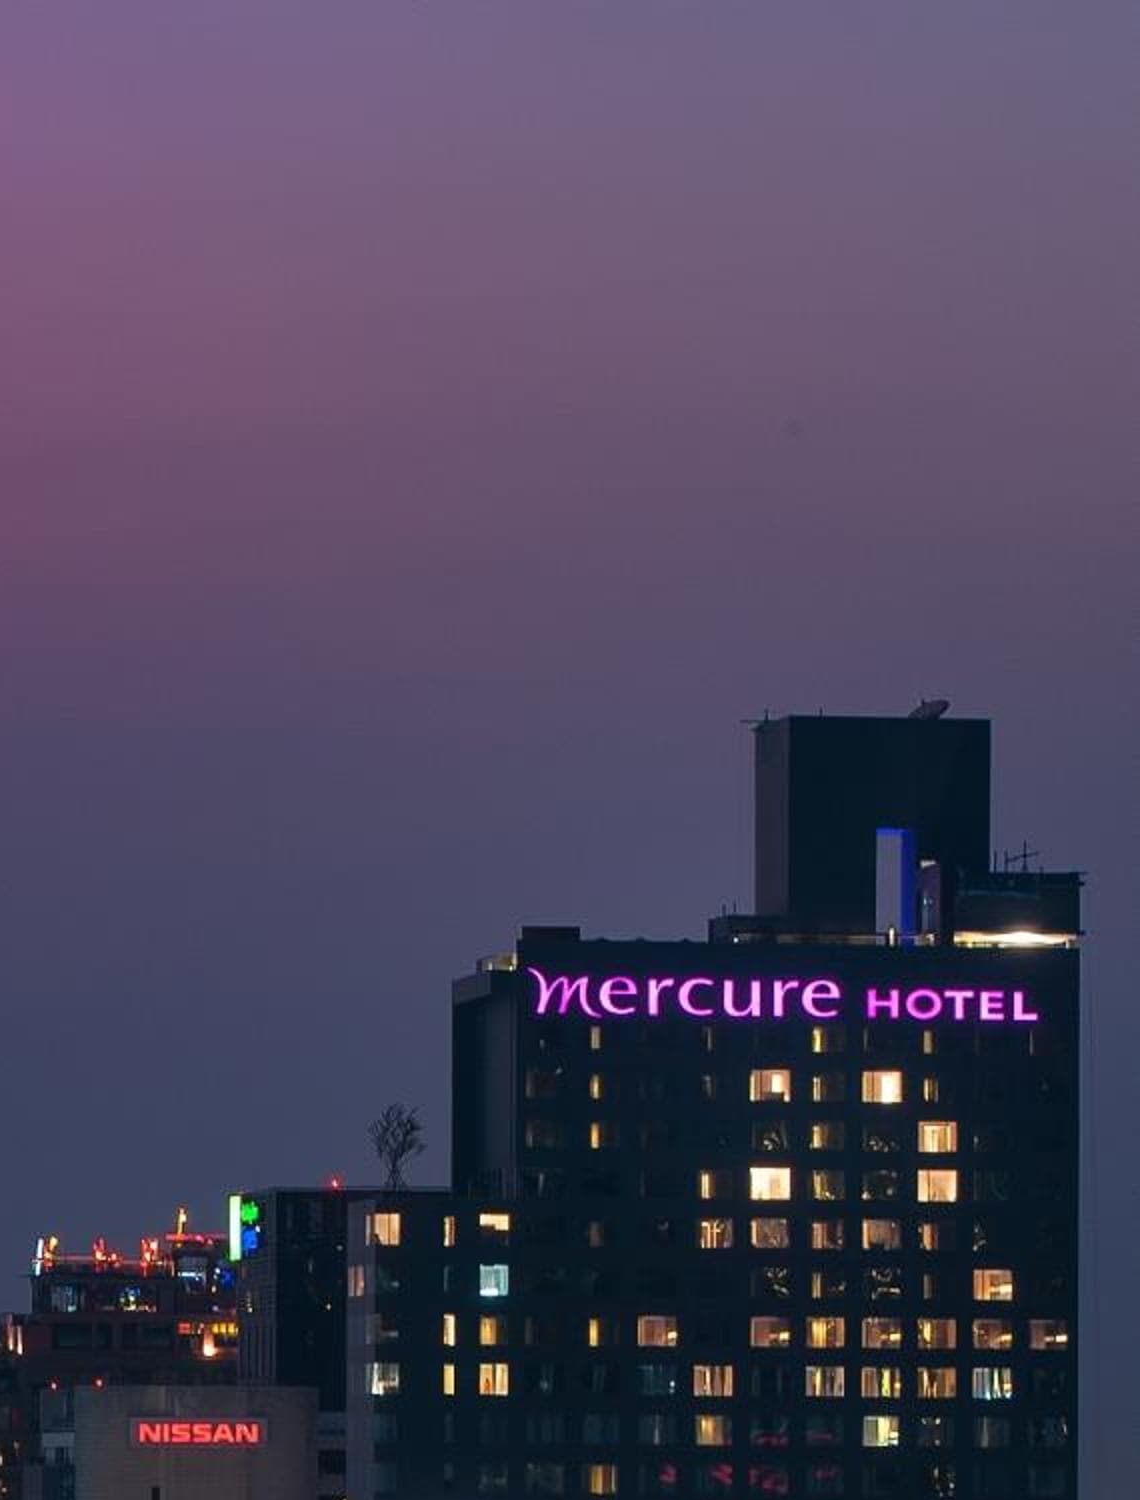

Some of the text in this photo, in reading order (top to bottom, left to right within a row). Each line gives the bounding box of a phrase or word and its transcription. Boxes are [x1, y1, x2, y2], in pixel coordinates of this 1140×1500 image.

[527, 965, 1038, 1021] mercure HOTEL
[139, 1422, 259, 1443] NISSAN
